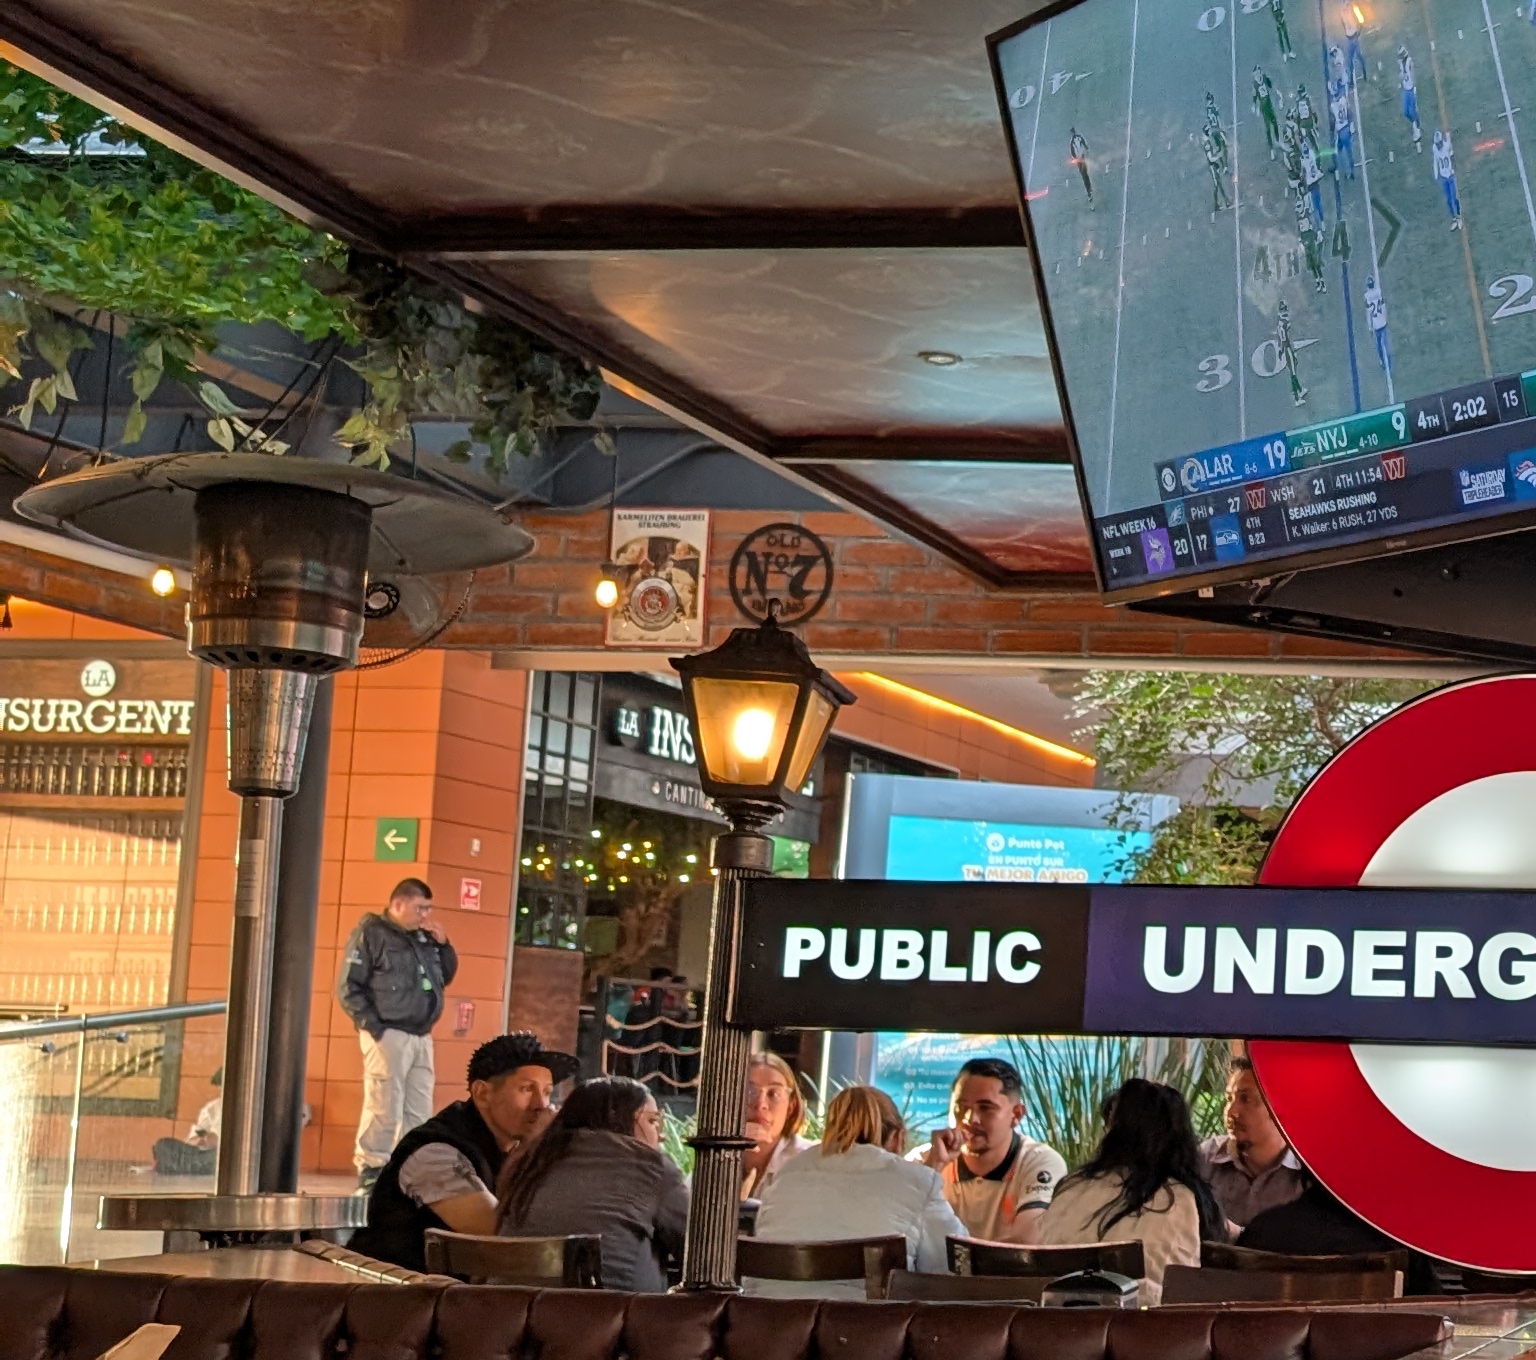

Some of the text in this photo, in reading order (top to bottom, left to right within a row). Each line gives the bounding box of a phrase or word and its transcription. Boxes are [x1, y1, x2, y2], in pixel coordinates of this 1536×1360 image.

[1417, 389, 1519, 430] 4TH 2:02 15
[1316, 409, 1406, 453] NYJ 4-10 9
[1203, 453, 1234, 479] LAR
[1263, 442, 1286, 470] 19
[1269, 466, 1382, 503] WSH 21 4TH 11:54
[1470, 468, 1506, 489] SATURDAY
[1463, 484, 1503, 503] TRIPLEHEADER
[1190, 497, 1241, 521] PHI 27
[1288, 491, 1377, 520] SEAHAWKS RUSHING
[1338, 512, 1366, 528] RUSH,
[1366, 509, 1377, 523] 27
[1378, 505, 1398, 520] YDS
[638, 521, 682, 529] STRAUBING
[1102, 516, 1157, 540] NFL WEEK 16
[1246, 516, 1261, 529] 4TH
[767, 533, 801, 549] OLD
[1174, 535, 1208, 556] 20 17
[788, 553, 822, 601] 7
[84, 669, 111, 687] LA
[618, 708, 640, 738] LA
[1008, 837, 1043, 849] Punto
[987, 868, 1032, 880] MEJOR
[1038, 868, 1086, 881] AMIGO
[783, 926, 1042, 984] PUBLIC
